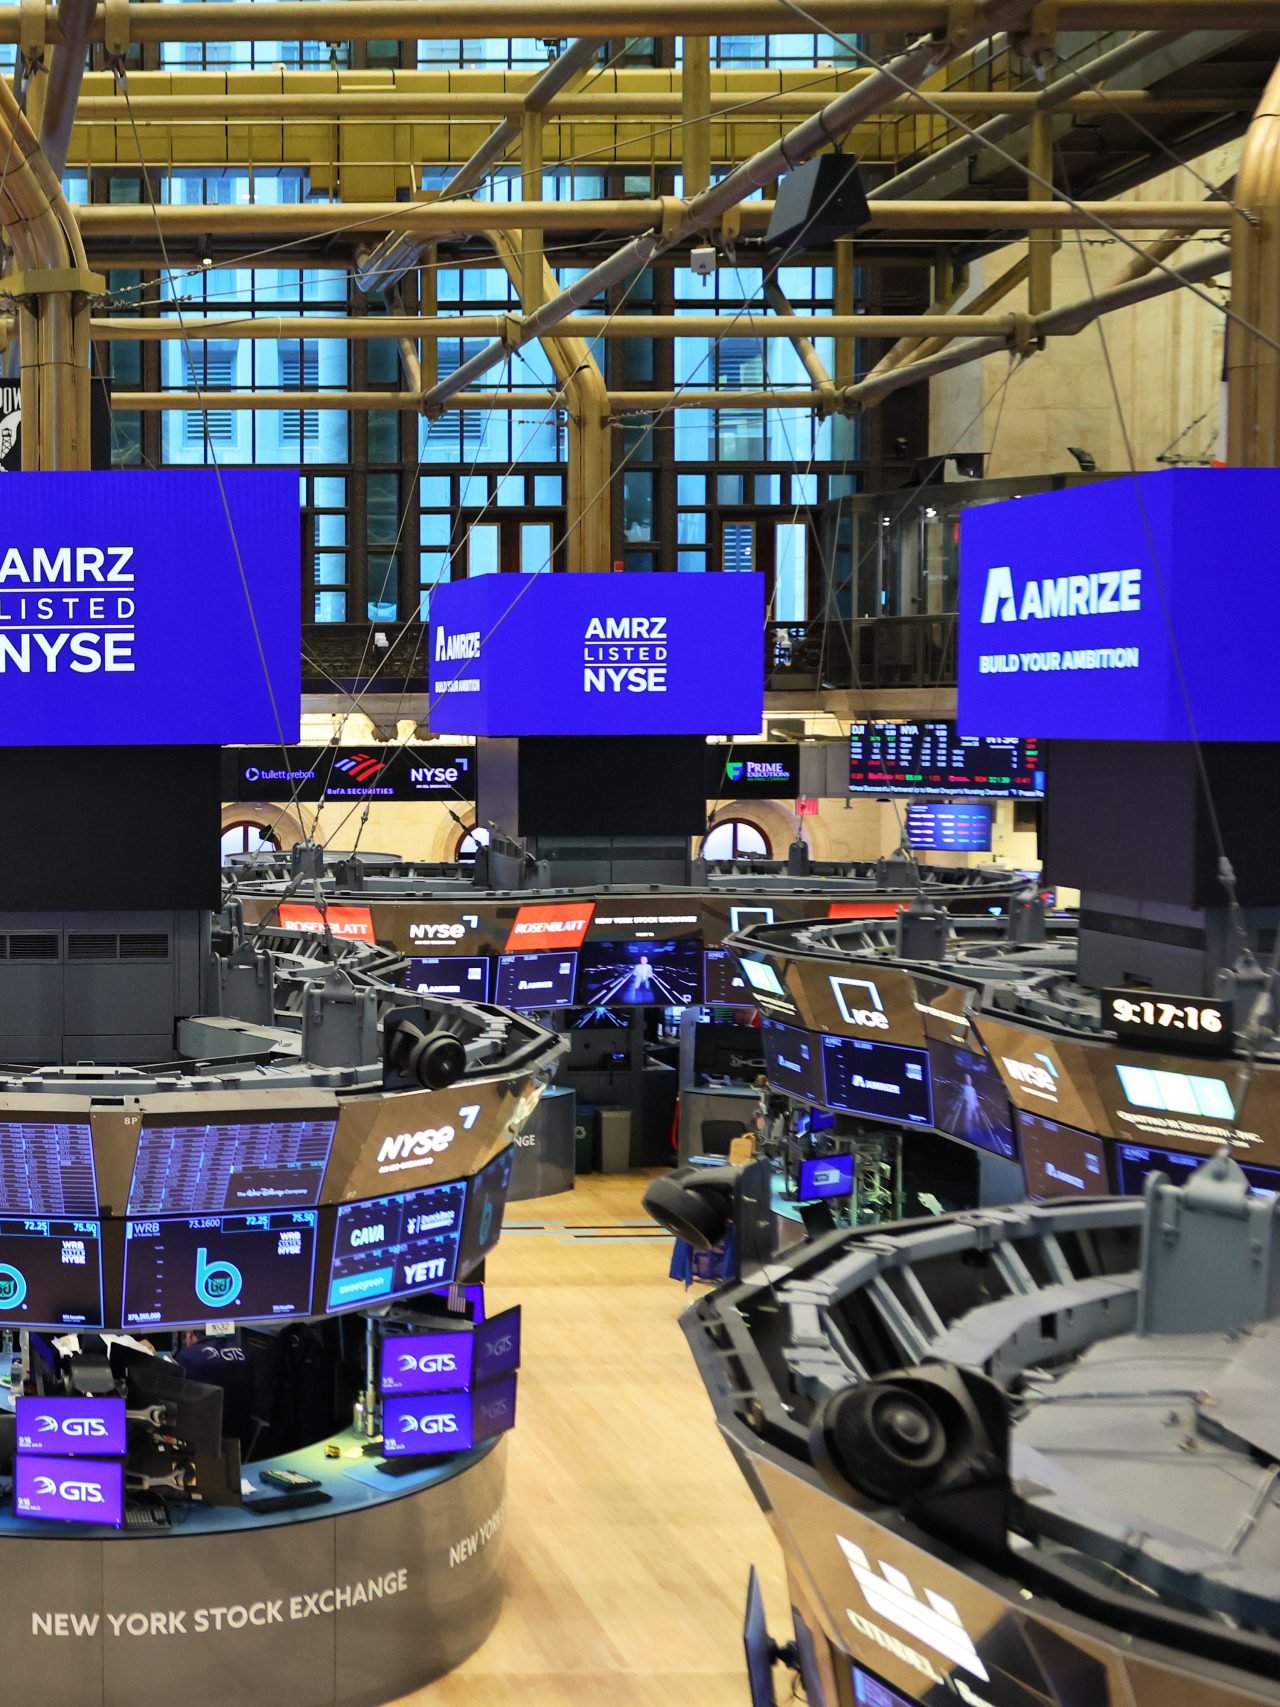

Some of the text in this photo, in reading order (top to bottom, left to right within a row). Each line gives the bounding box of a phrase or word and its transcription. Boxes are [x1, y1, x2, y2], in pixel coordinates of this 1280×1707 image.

[1019, 568, 1141, 620] AMRIZE
[584, 617, 667, 639] AMRZ
[447, 631, 480, 660] AMRIZE
[584, 647, 667, 661] LISTED
[979, 647, 1140, 673] BUILD YOUR AMBITION
[584, 668, 667, 692] NYSE
[851, 725, 919, 735] DJI NYA
[261, 769, 315, 781] tullett prebon
[746, 762, 783, 772] PRIME
[285, 920, 368, 934] ROSENBLATT
[514, 919, 586, 934] ROSENBLATT
[1113, 999, 1222, 1032] 9:17:16
[124, 1117, 137, 1125] 8P
[24, 1221, 47, 1230] 72.25
[73, 1223, 97, 1232] 75.50
[134, 1213, 314, 1233] WRB 73.1600 72.25 75.50
[62, 1240, 85, 1249] WRB
[280, 1232, 301, 1241] WRB
[351, 1224, 385, 1247] CAVA
[278, 1246, 301, 1255] NYSE
[61, 1255, 86, 1265] NYSE
[404, 1258, 447, 1285] YETI
[339, 1276, 385, 1294] sweetgreen
[221, 1347, 245, 1361] GTS
[494, 1335, 512, 1356] GTS
[419, 1354, 456, 1372] GTS
[62, 1418, 107, 1436] GTS
[420, 1414, 458, 1434] GTS
[59, 1481, 104, 1502] GTS
[450, 1531, 478, 1568] NEW
[31, 1568, 408, 1636] NEW YORK STOCK EXCHANGE
